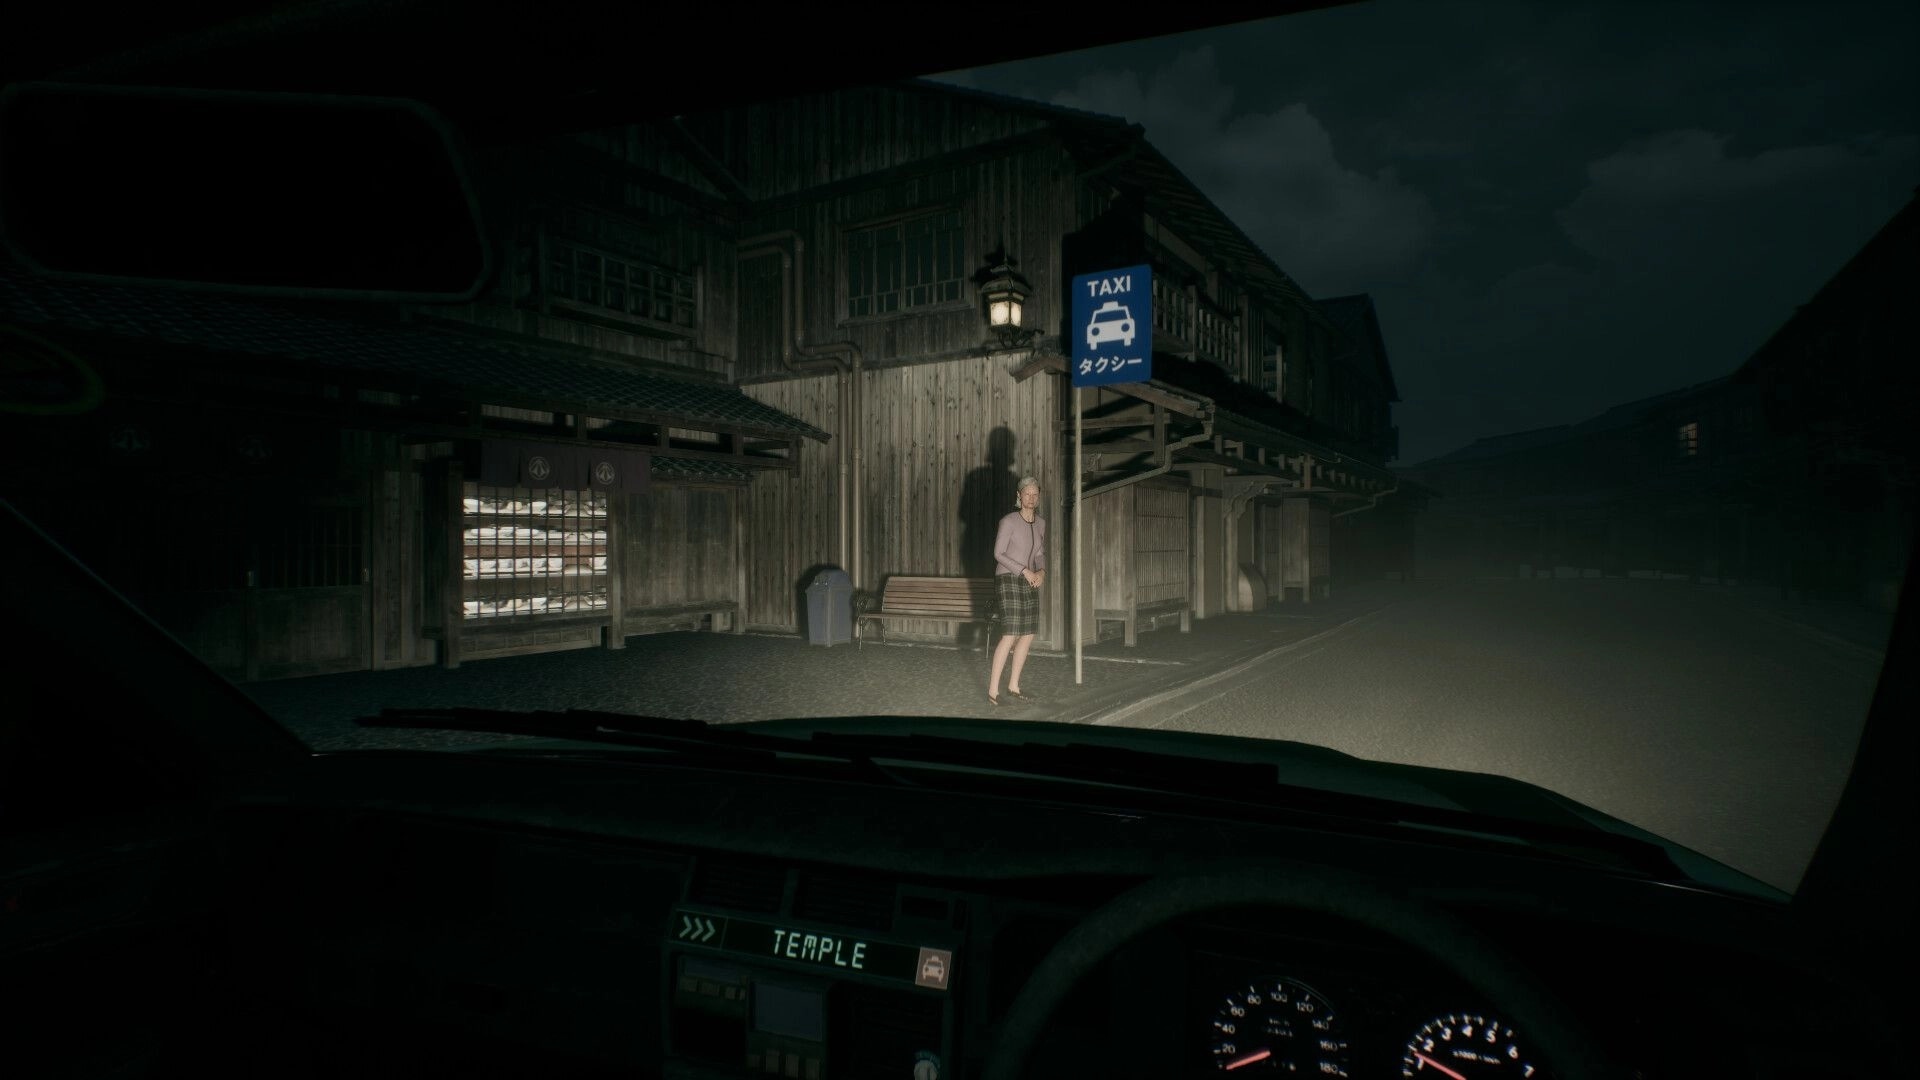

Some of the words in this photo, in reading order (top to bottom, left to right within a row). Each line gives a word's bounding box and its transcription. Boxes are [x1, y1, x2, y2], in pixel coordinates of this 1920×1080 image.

[1087, 275, 1131, 297] TAXI
[1079, 356, 1142, 375] タクシー
[773, 929, 867, 970] TEMPLE
[1270, 991, 1288, 1003] 100
[1230, 1007, 1245, 1018] 60
[1296, 1001, 1314, 1013] 120
[1221, 1023, 1236, 1034] 40
[1312, 1019, 1329, 1031] 140
[1461, 1024, 1474, 1038] 4
[1441, 1027, 1453, 1042] 3
[1486, 1029, 1497, 1044] 5
[1221, 1043, 1236, 1055] 20
[1319, 1040, 1338, 1052] 160
[1423, 1038, 1435, 1053] 2
[1507, 1044, 1521, 1060] 6
[1319, 1062, 1339, 1074] 180
[1523, 1064, 1537, 1079] 7
